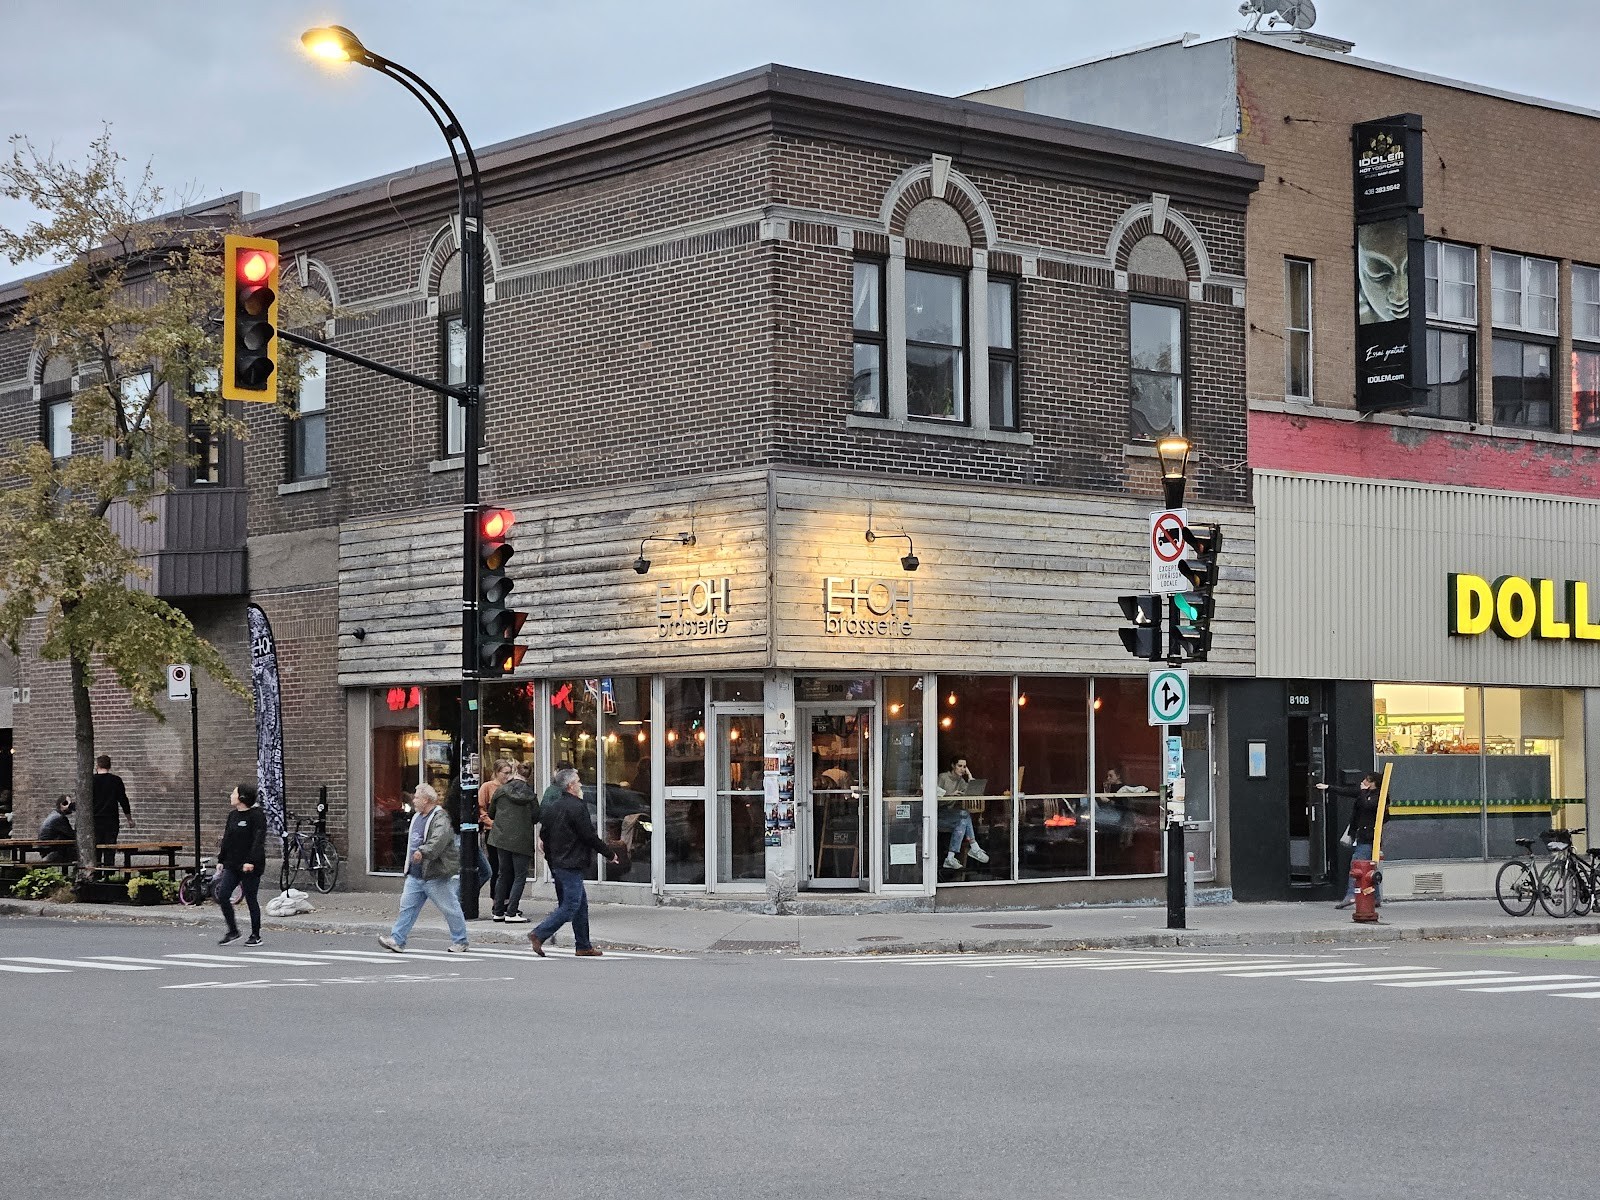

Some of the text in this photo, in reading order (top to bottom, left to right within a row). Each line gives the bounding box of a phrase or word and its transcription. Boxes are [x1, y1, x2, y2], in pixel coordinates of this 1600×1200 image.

[1359, 152, 1404, 167] IDOLEM
[1365, 345, 1384, 361] Essai
[1368, 374, 1404, 384] IDOLEM.com
[658, 612, 728, 638] brasserie
[825, 611, 913, 637] brasserie
[1289, 695, 1310, 705] 8108
[1377, 714, 1386, 726] 3
